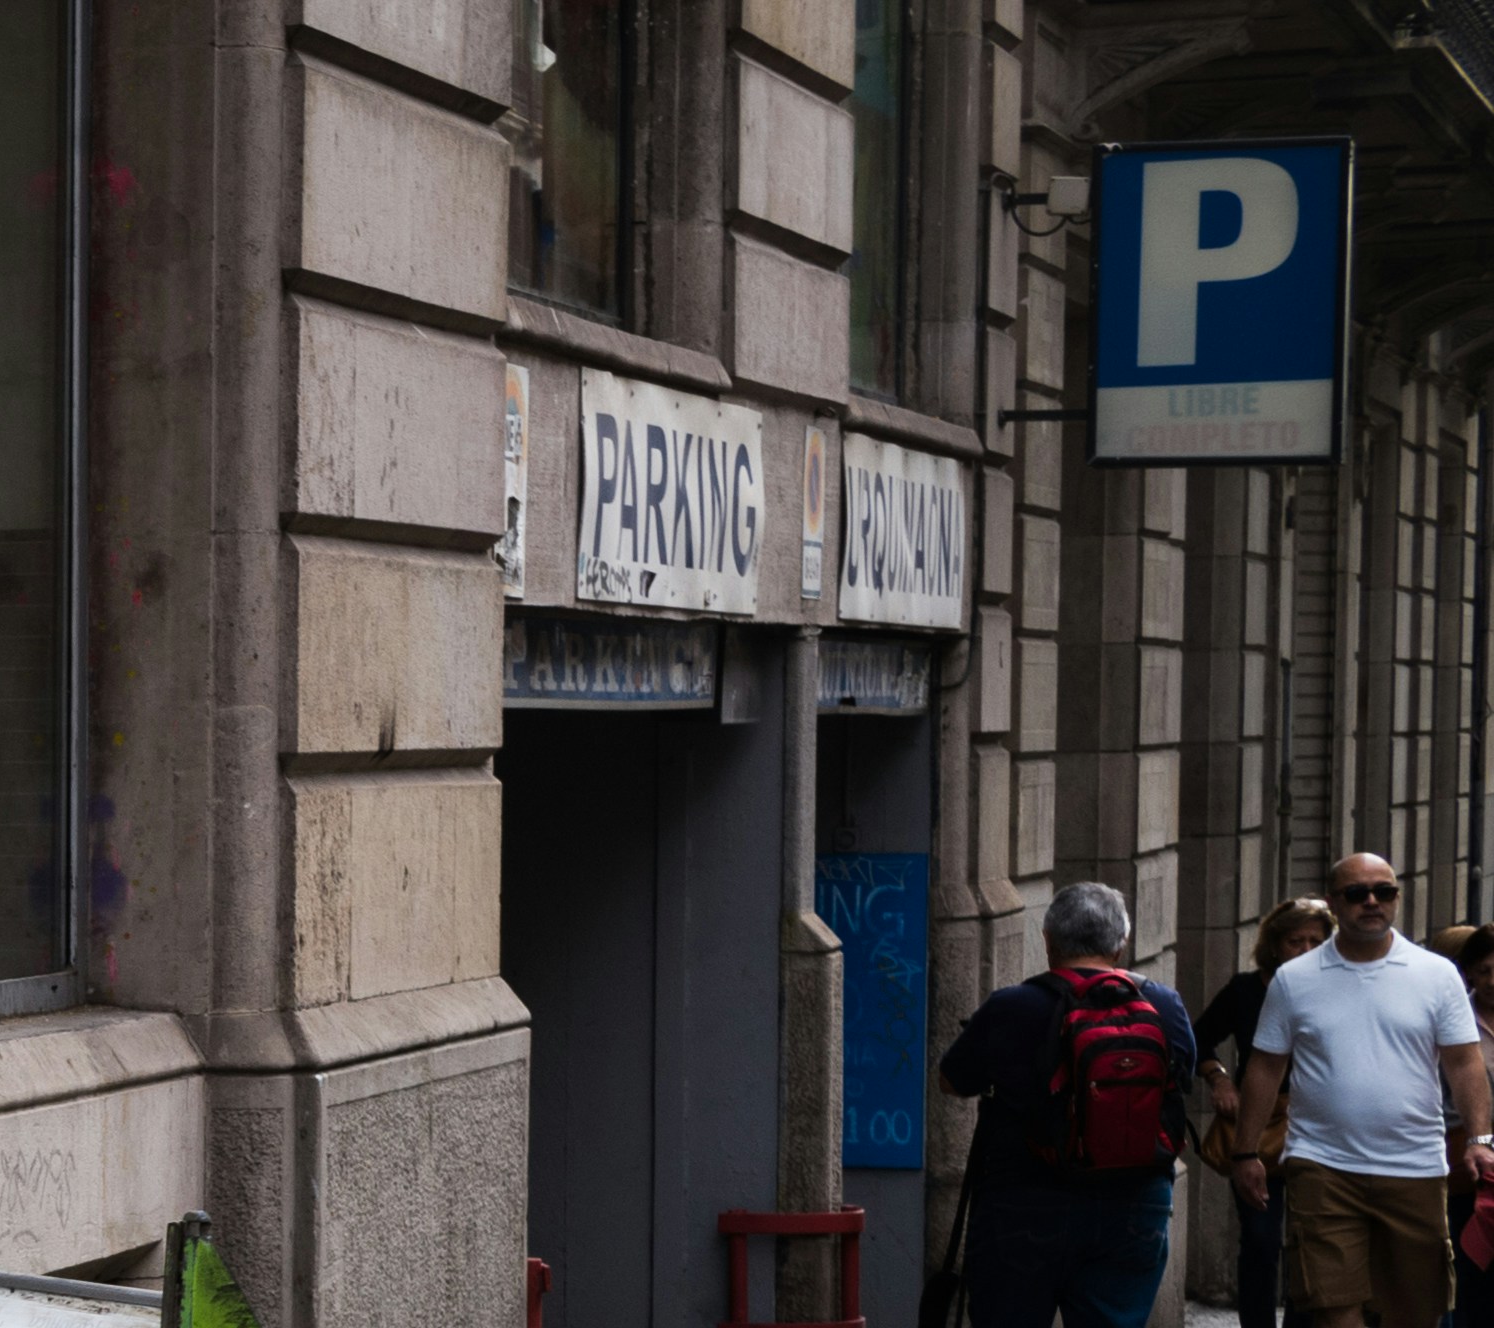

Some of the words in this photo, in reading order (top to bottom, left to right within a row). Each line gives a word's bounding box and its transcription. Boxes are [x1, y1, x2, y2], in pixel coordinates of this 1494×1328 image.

[1136, 157, 1299, 367] P
[1125, 420, 1301, 452] COMPLETO
[1167, 385, 1261, 417] LIBRE
[594, 412, 756, 577] PARKING
